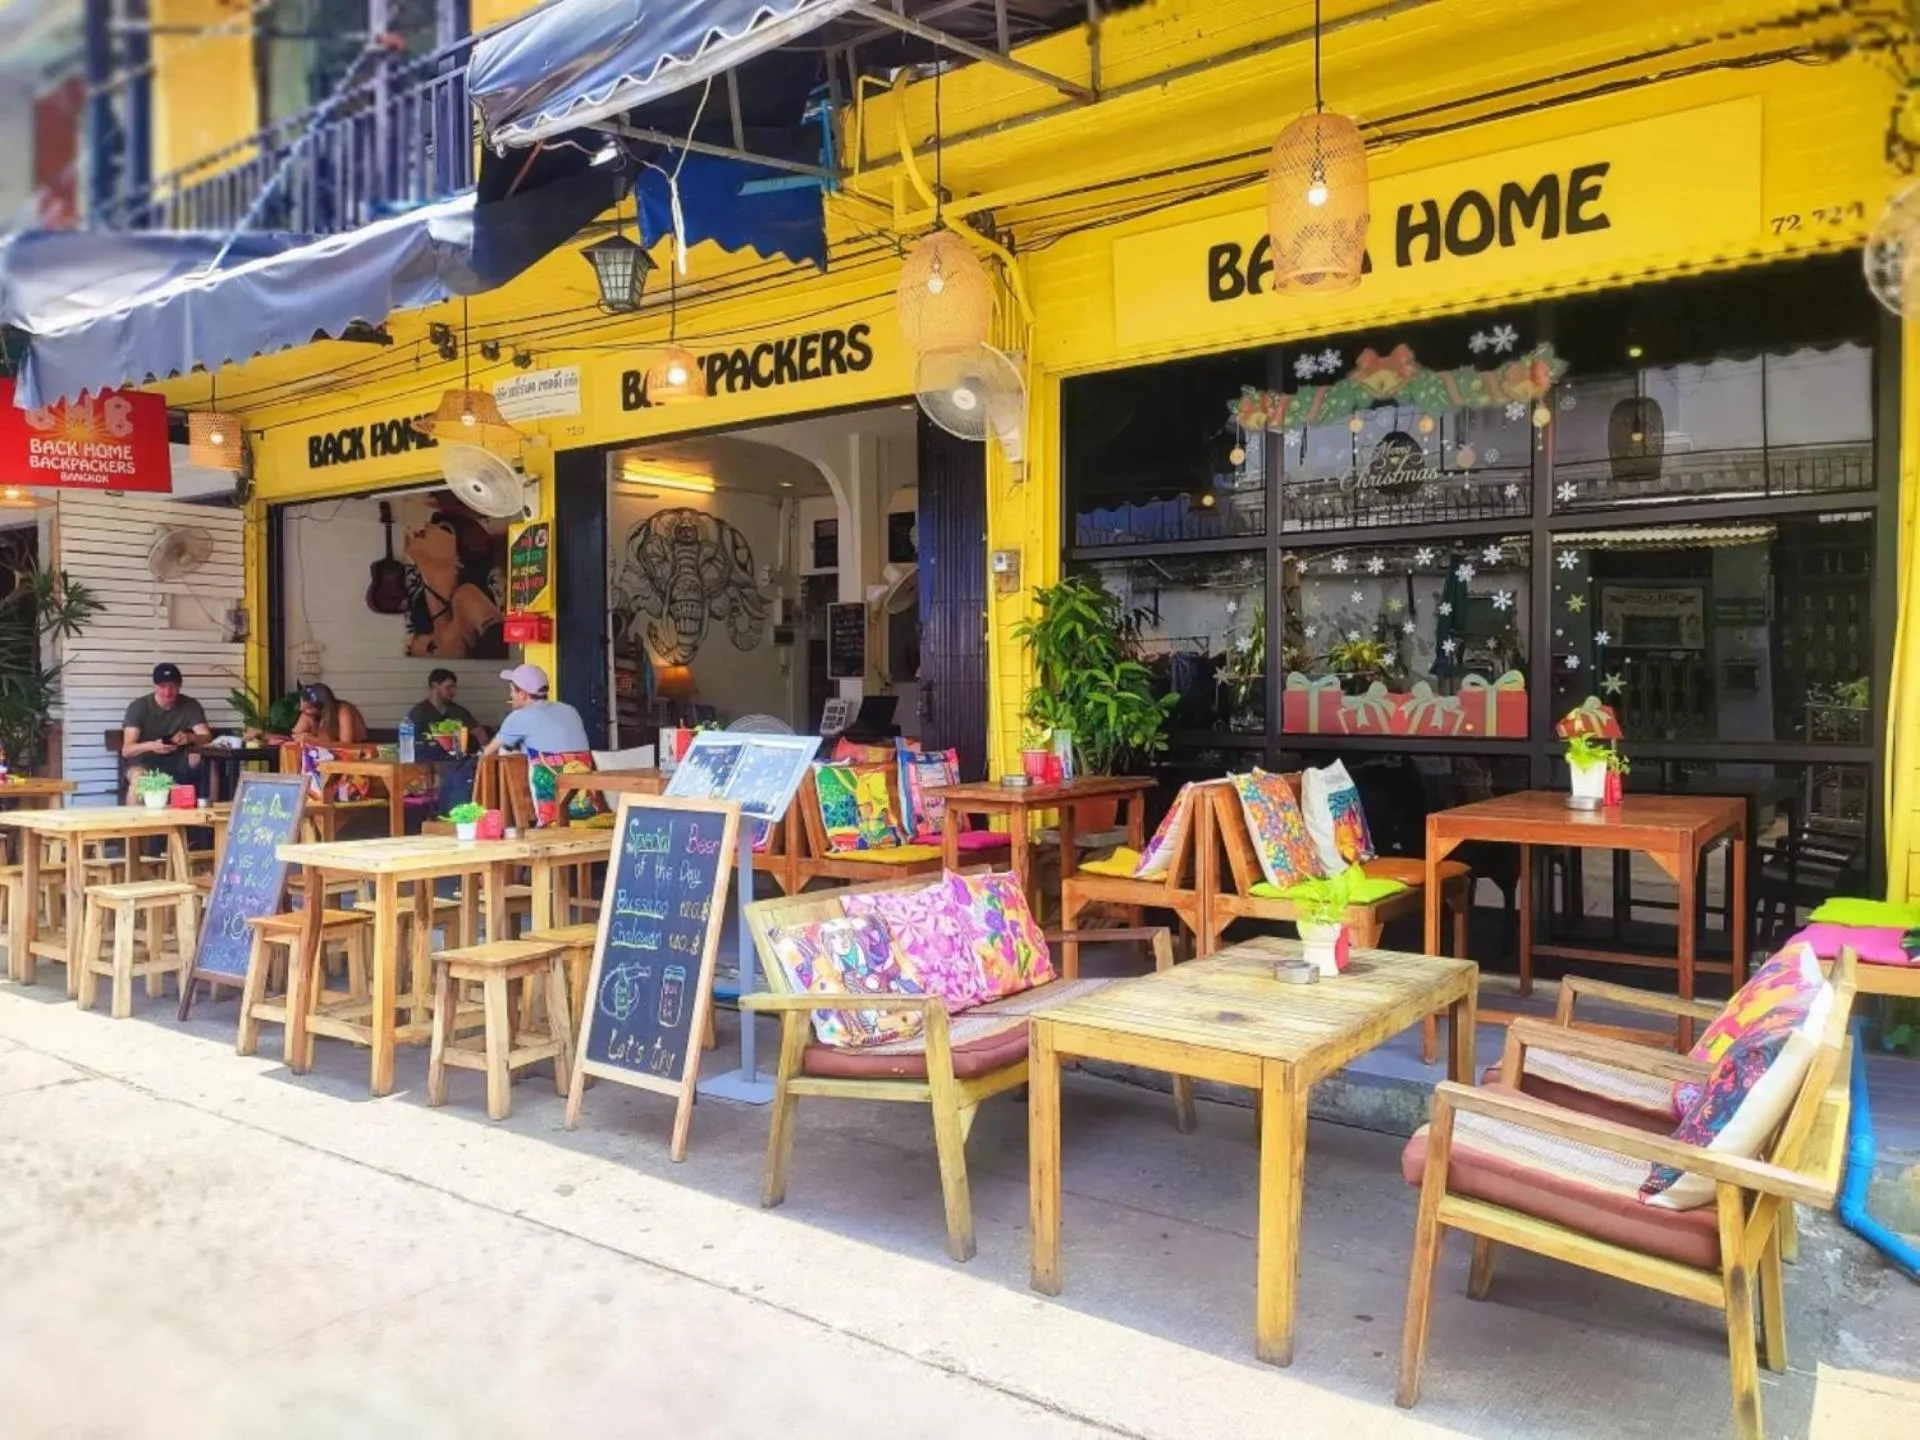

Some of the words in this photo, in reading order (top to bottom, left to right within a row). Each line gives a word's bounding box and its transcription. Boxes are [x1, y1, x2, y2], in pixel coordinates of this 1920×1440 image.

[1395, 162, 1612, 268] HOME
[622, 325, 873, 411] BPACKERS
[29, 455, 136, 475] BACKPACKERS
[30, 438, 77, 457] BACK
[84, 444, 134, 461] HOME
[308, 425, 366, 469] BACK
[60, 472, 109, 483] BANGKOK
[1340, 456, 1439, 491] Christmas
[626, 818, 674, 857] Special
[685, 823, 720, 854] Beer
[634, 854, 648, 880] of
[655, 857, 673, 880] the
[680, 860, 703, 889] Day
[608, 1028, 645, 1064] Let's
[650, 1036, 676, 1077] try
